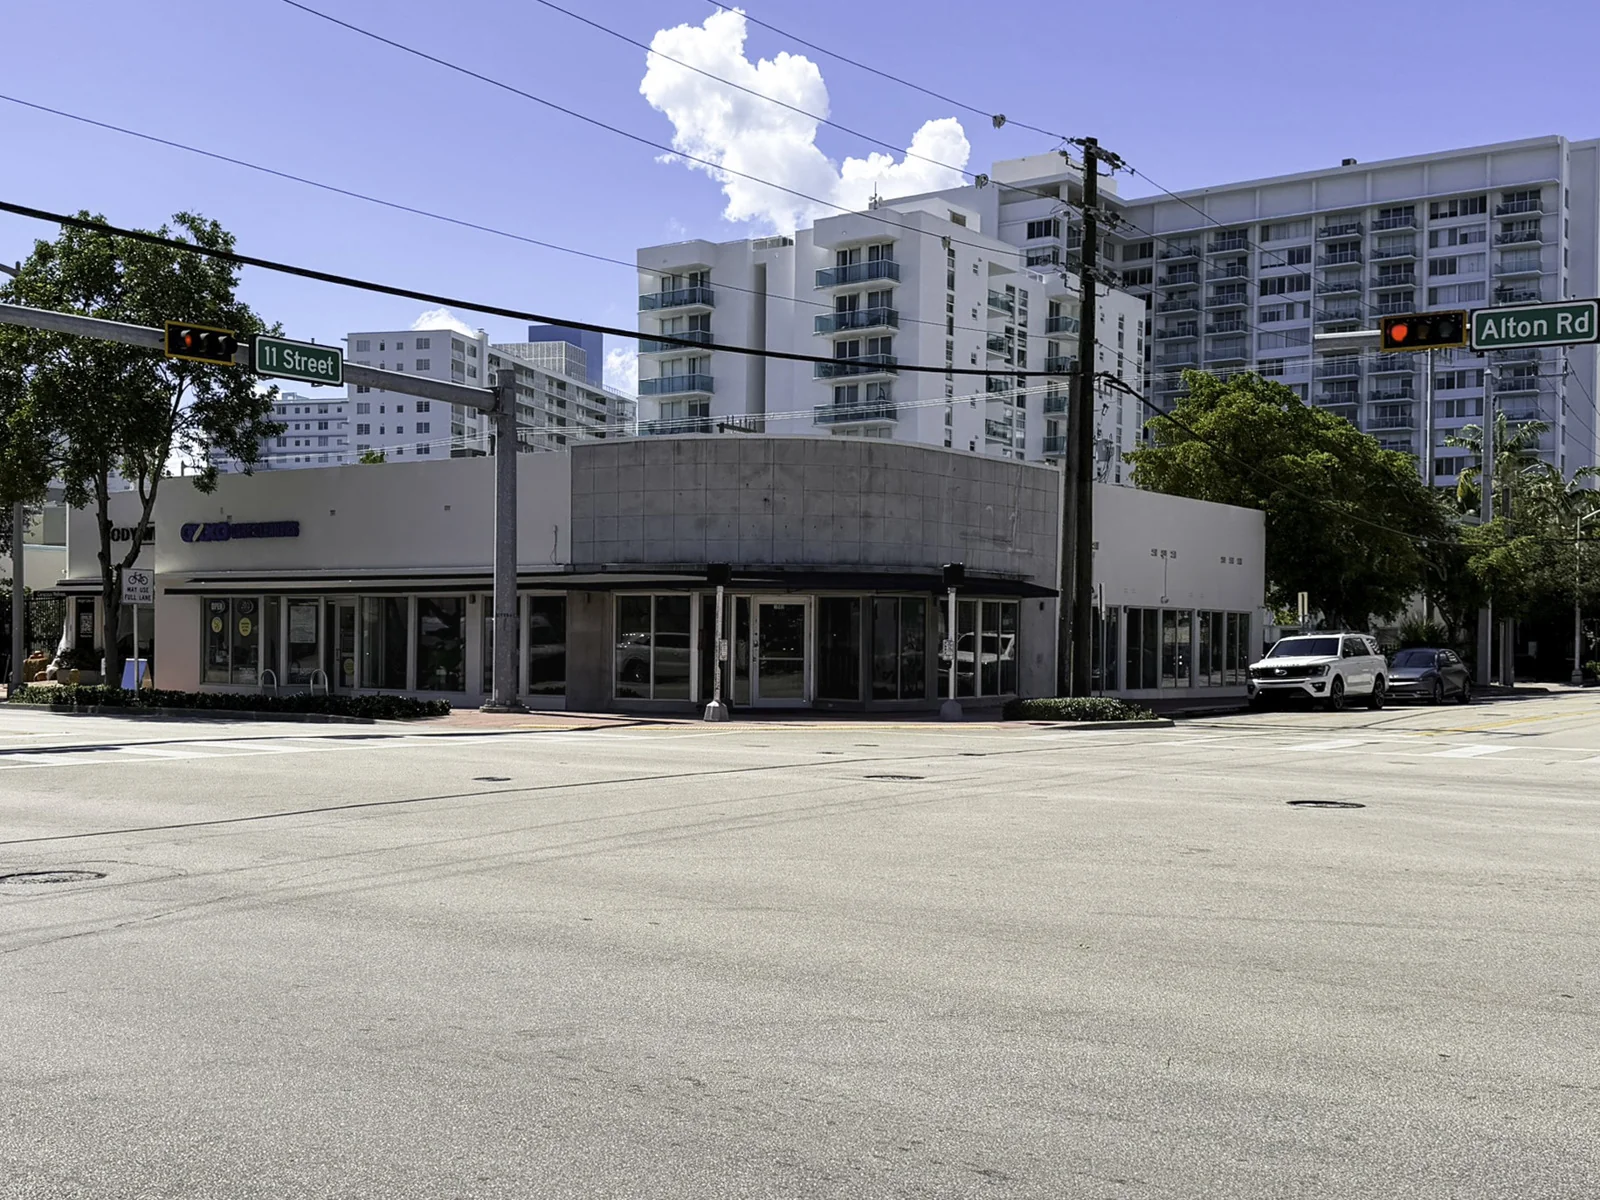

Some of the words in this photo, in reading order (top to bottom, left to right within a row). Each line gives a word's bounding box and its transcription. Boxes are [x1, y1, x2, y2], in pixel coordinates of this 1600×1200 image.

[1480, 317, 1548, 340] Alton
[1557, 311, 1589, 335] Rd
[264, 345, 277, 367] 11
[283, 348, 334, 376] Street
[111, 527, 139, 542] ODY
[138, 594, 152, 602] LANE
